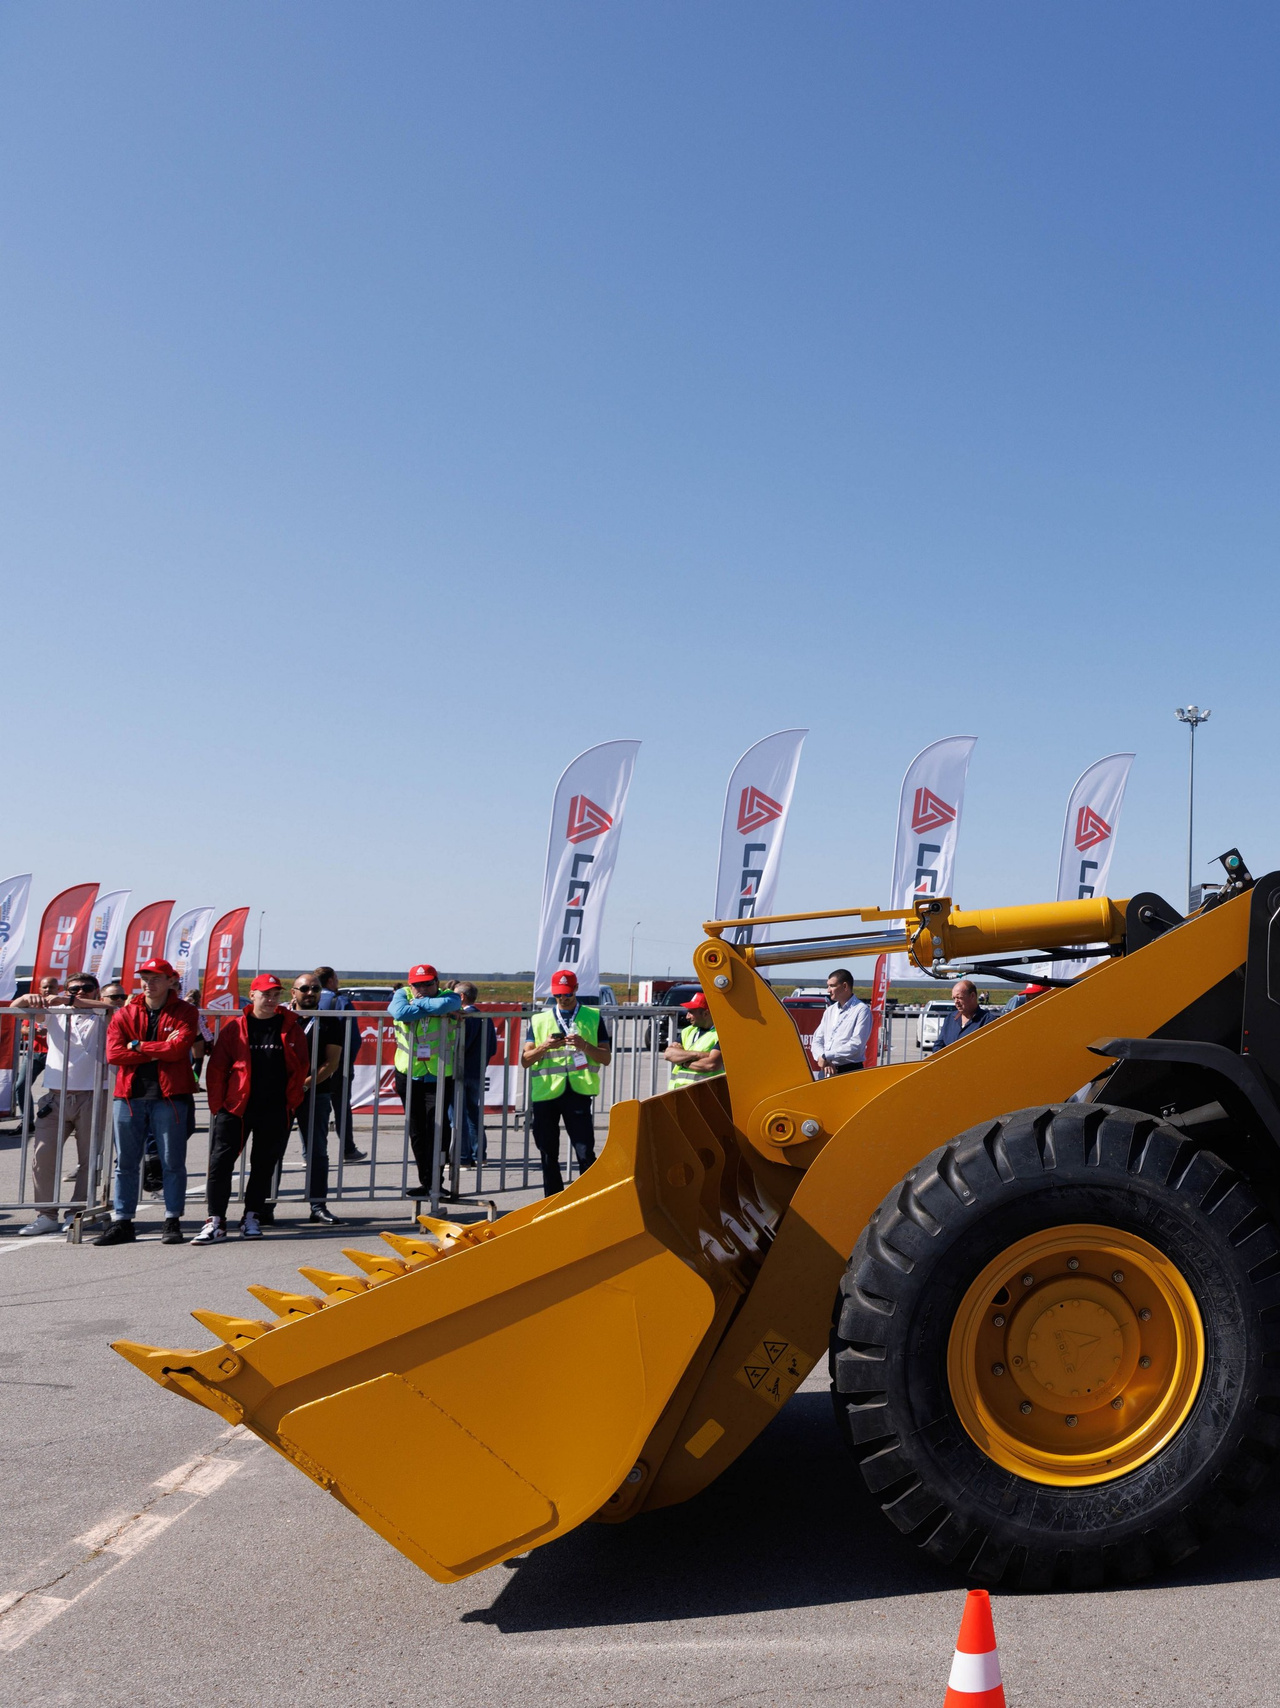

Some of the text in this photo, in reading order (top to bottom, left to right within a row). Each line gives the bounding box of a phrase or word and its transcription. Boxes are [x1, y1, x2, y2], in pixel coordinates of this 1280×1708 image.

[558, 853, 594, 963] LGCE
[93, 930, 108, 950] 30
[178, 940, 191, 958] 30
[215, 934, 233, 990] LGCE
